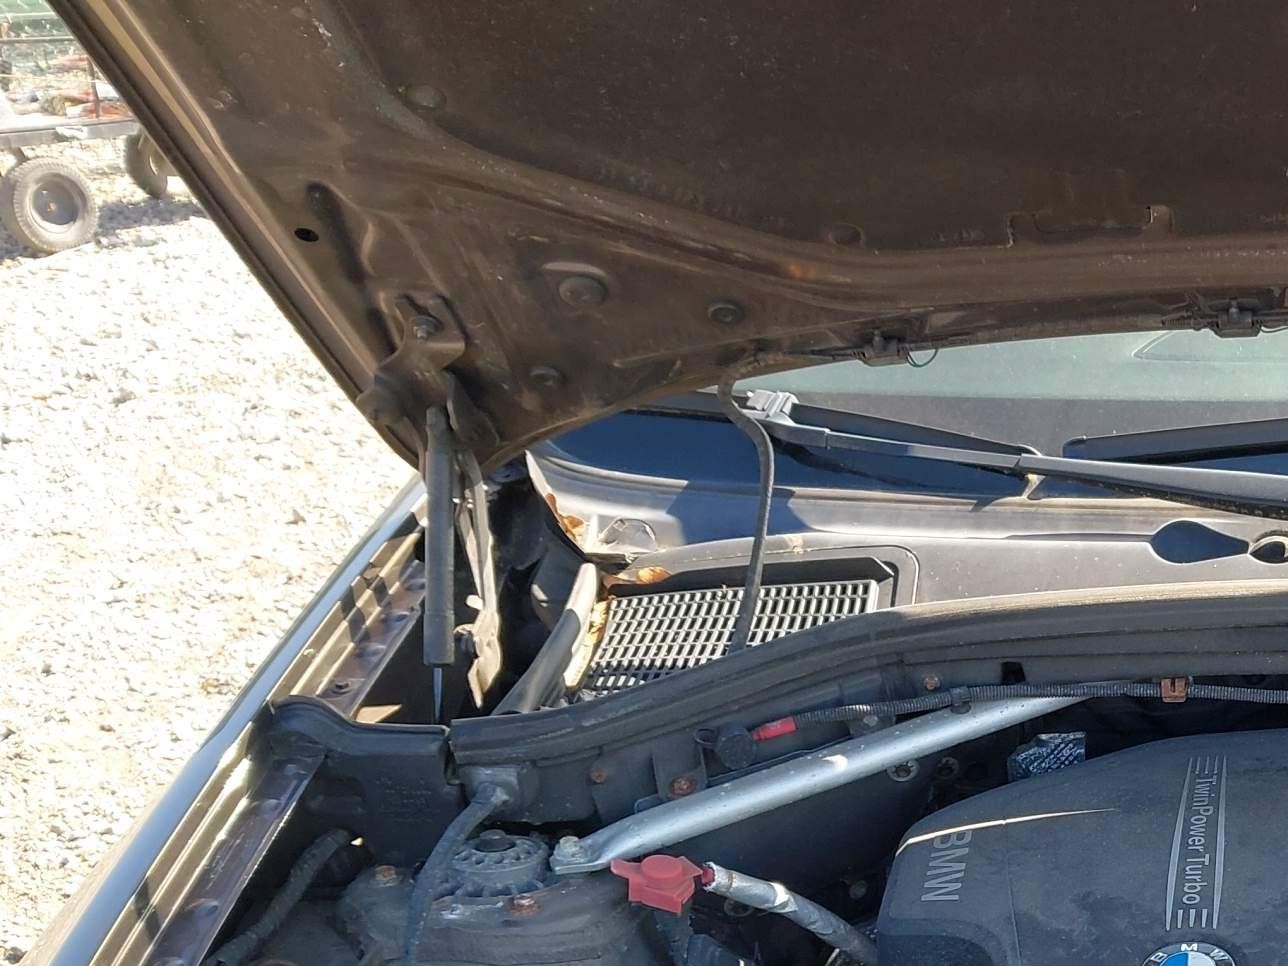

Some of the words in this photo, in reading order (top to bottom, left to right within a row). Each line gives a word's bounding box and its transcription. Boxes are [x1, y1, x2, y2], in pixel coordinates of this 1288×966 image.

[1187, 775, 1217, 851] TwinPower
[921, 830, 972, 901] BMW
[1183, 854, 1209, 905] Turbo
[1150, 943, 1229, 962] BMW
